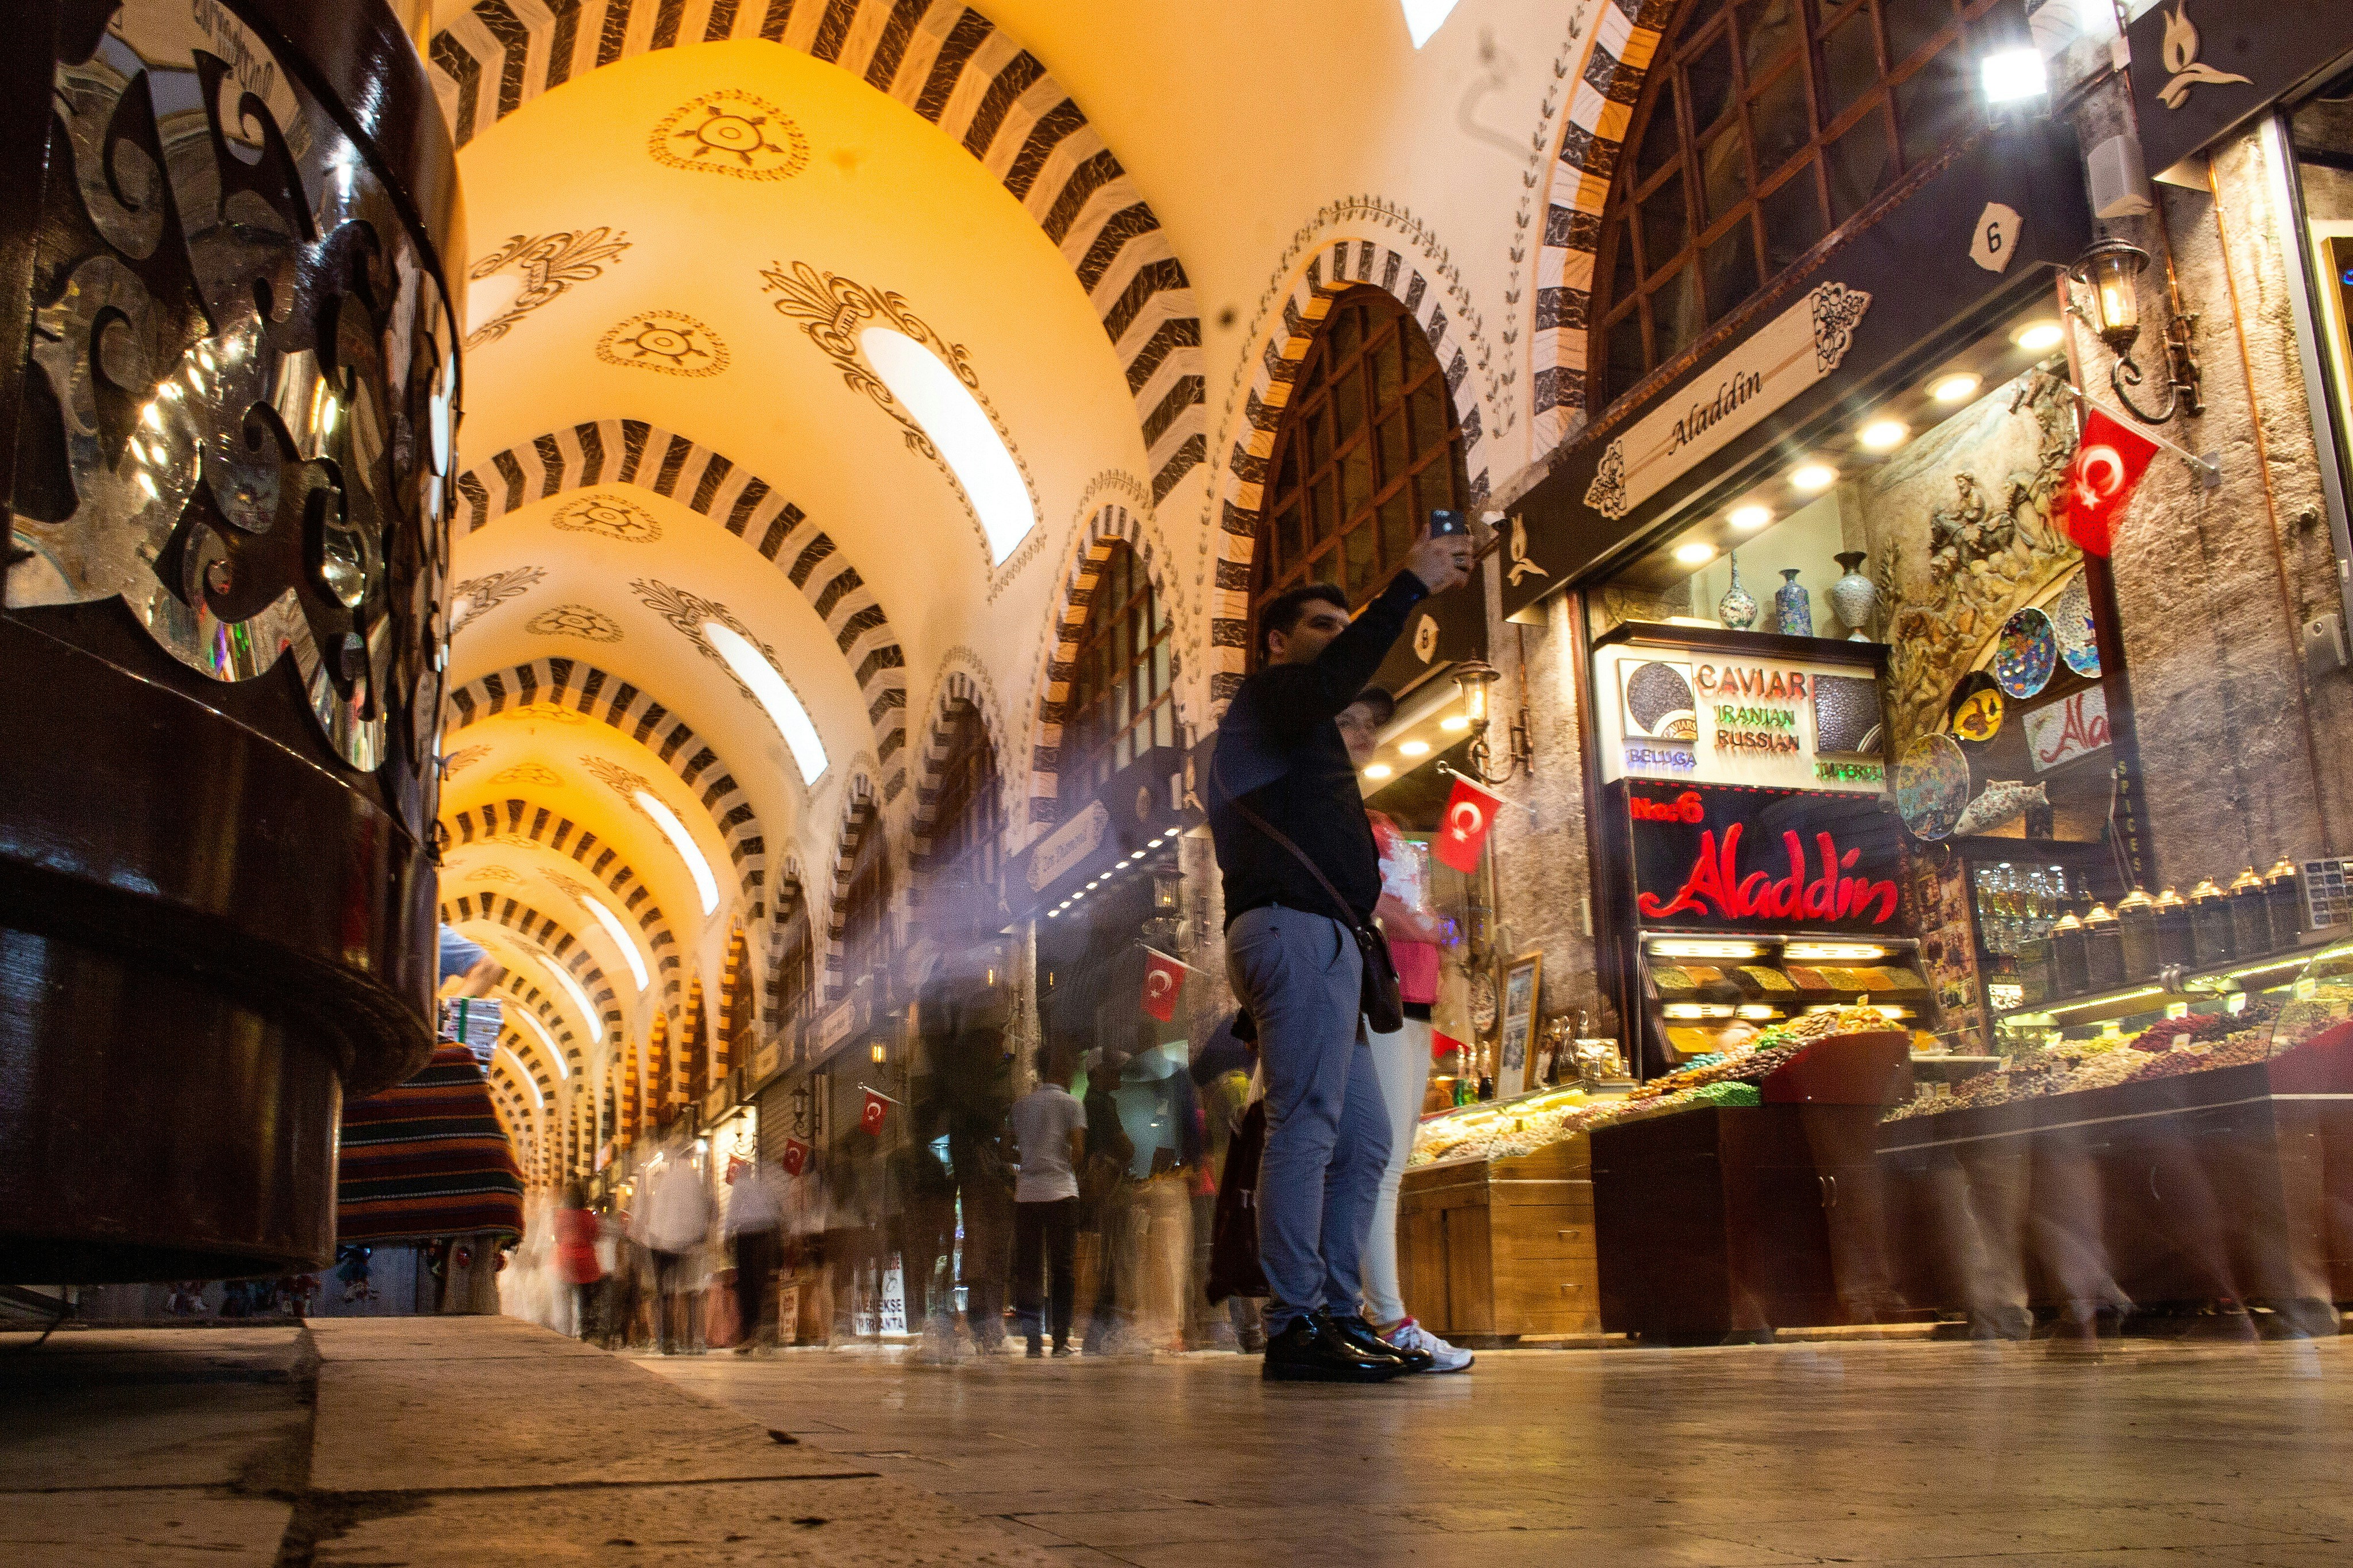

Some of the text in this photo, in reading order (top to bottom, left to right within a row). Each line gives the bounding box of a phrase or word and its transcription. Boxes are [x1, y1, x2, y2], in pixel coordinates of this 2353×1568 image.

[1986, 221, 2002, 253] 6
[1668, 371, 1763, 456] Aladdin
[1698, 664, 1807, 698] CAVIAR
[1714, 704, 1796, 726] IRANIAN
[1716, 729, 1800, 750] RUSSIAN
[1629, 748, 1698, 766] BELUGA
[2117, 760, 2142, 872] SPICES
[1637, 822, 1899, 924] Aladdin
